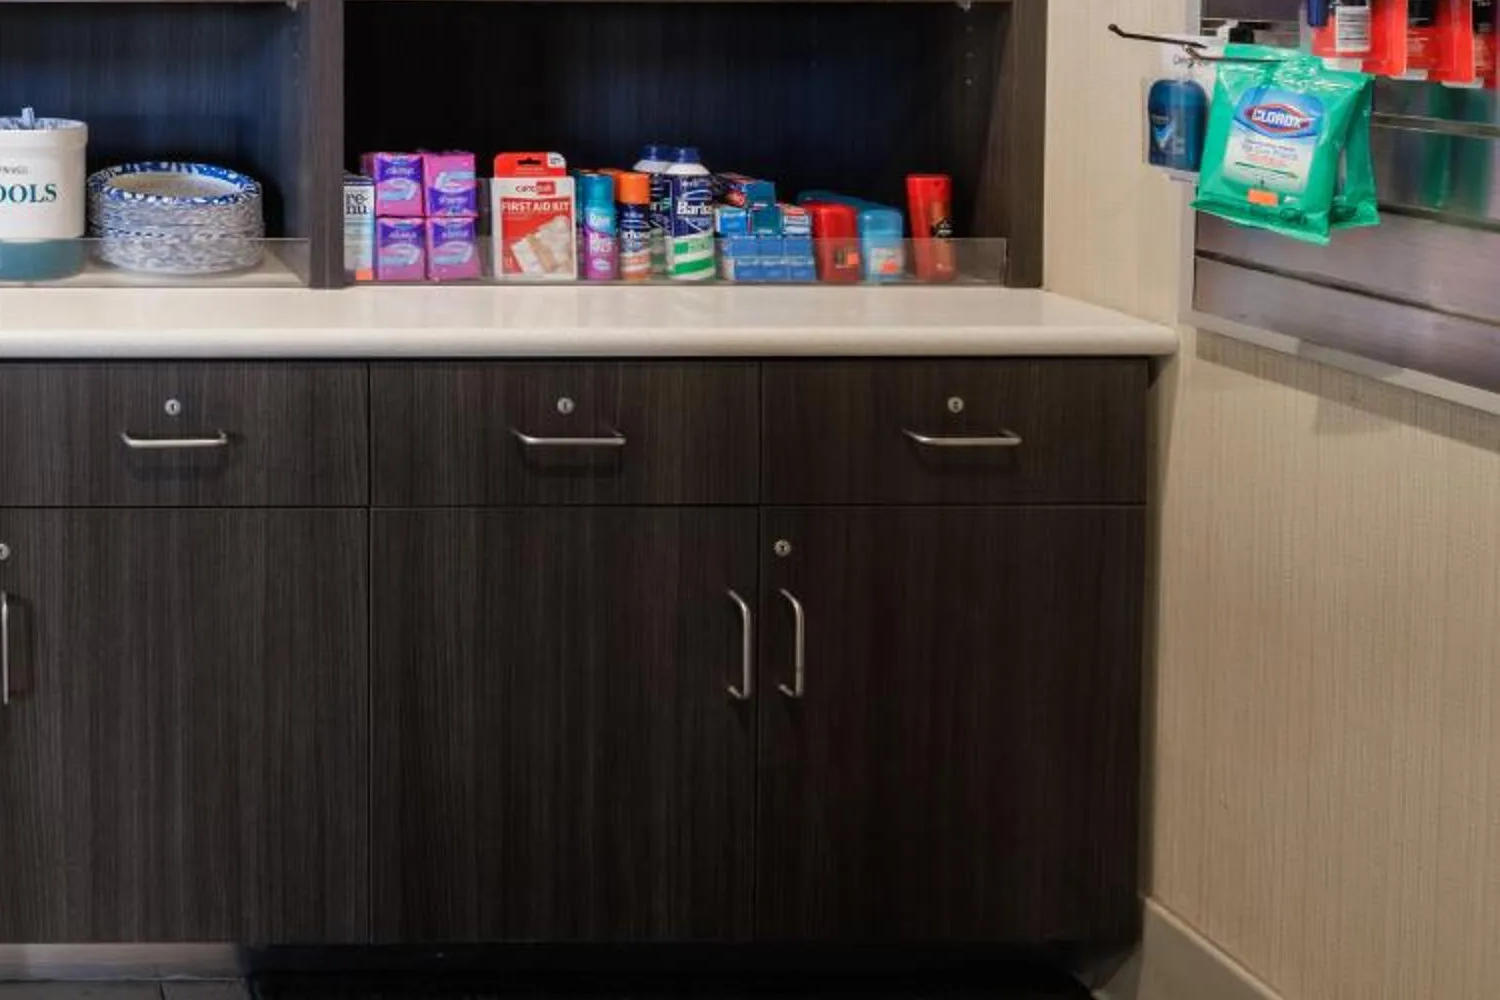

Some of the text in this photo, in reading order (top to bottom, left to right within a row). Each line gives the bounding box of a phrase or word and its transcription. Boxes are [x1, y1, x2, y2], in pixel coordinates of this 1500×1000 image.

[1251, 107, 1302, 129] CLOROX
[501, 201, 532, 213] FIRST
[532, 201, 551, 213] AID
